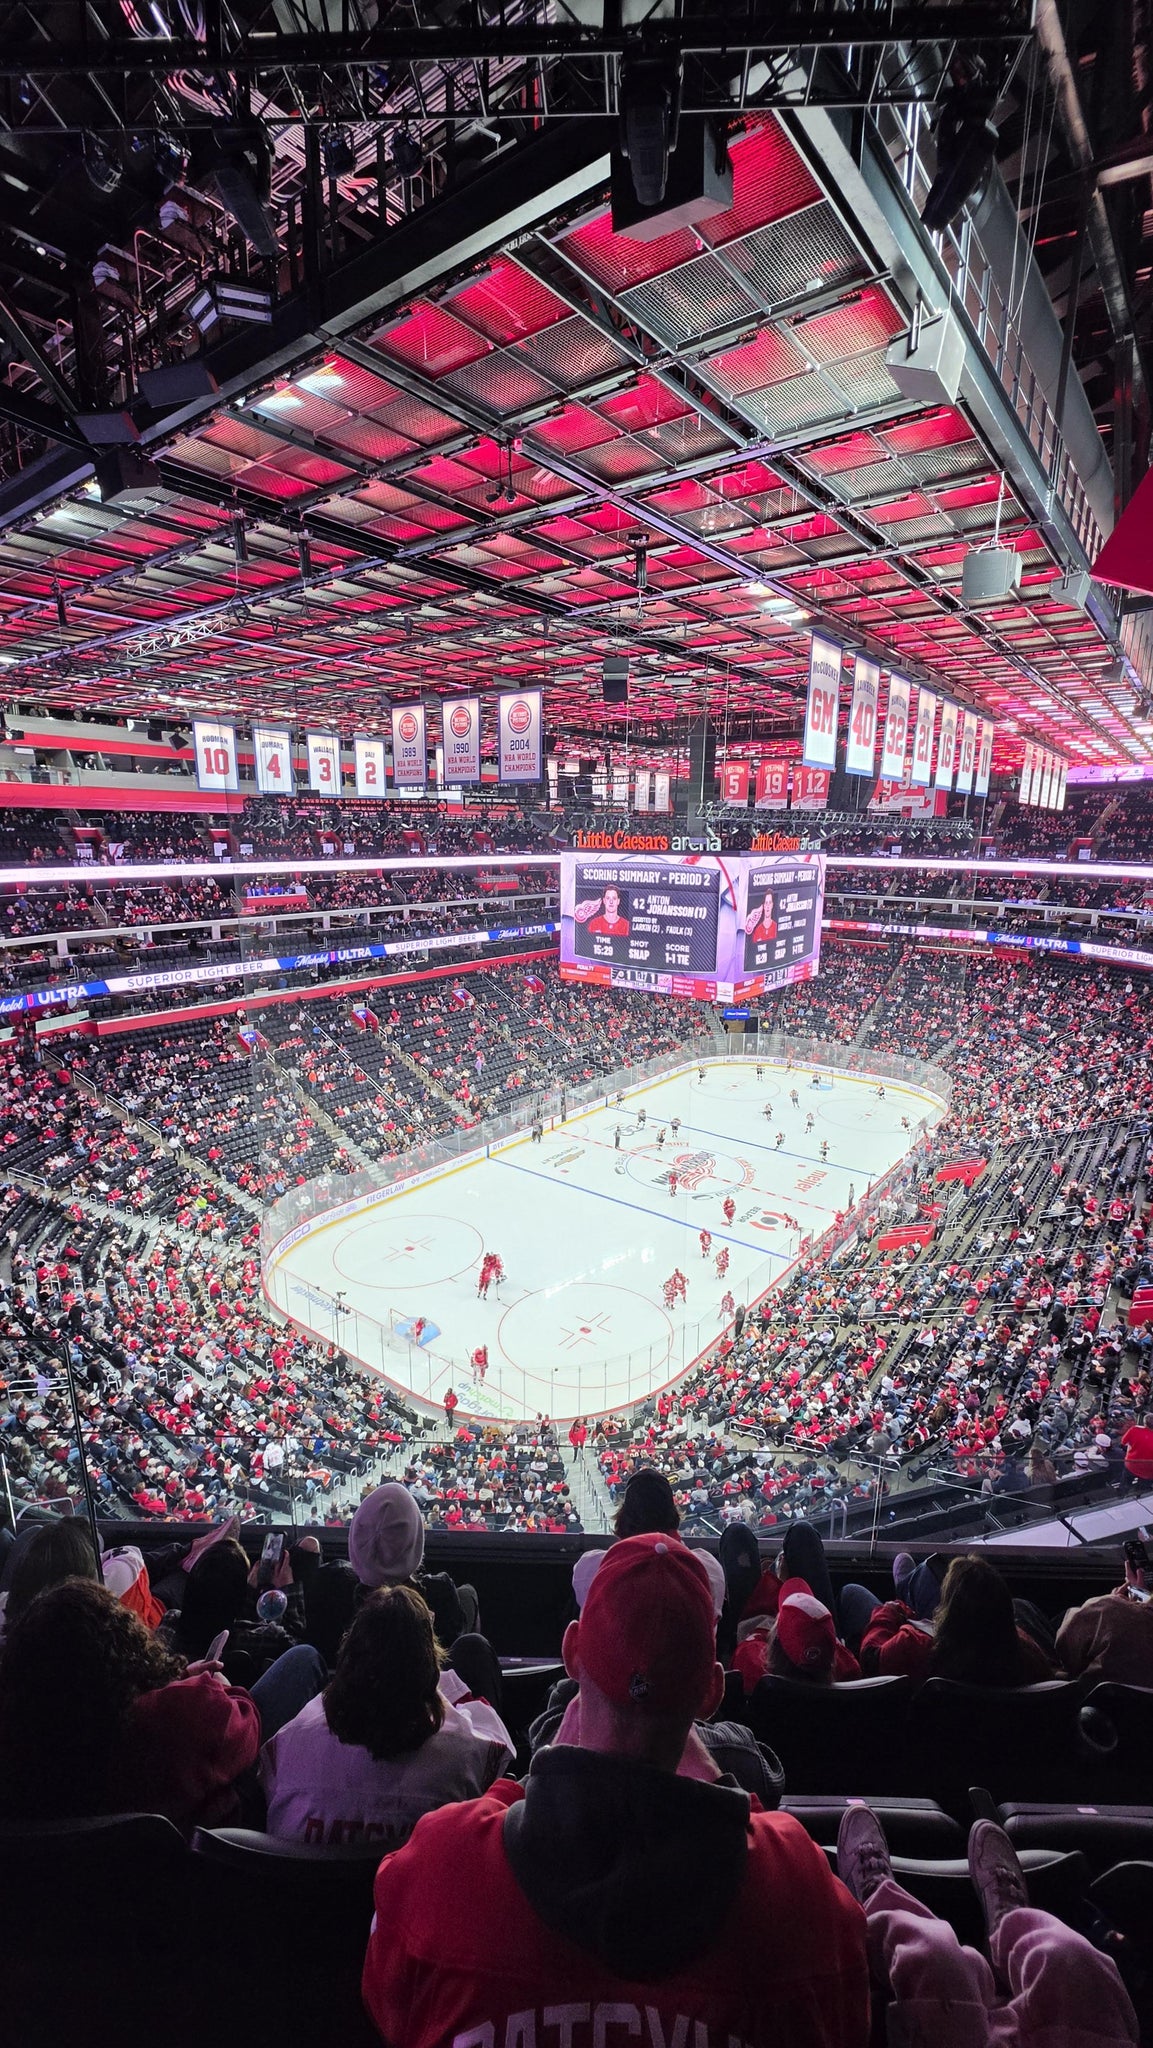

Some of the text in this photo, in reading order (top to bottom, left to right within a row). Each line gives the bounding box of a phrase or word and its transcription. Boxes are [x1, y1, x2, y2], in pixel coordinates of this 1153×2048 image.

[810, 688, 835, 734] GM
[852, 701, 874, 747] 40
[510, 739, 529, 750] 2004
[887, 713, 905, 757] 32
[917, 723, 930, 762] 21
[453, 742, 469, 754] 1990
[941, 733, 953, 768] 16
[962, 740, 973, 773] 15
[204, 747, 230, 775] 10
[266, 753, 281, 778] 4
[447, 755, 476, 764] NBA WORLD
[504, 764, 536, 772] CHAMPIONS
[981, 748, 988, 777] 11
[319, 757, 331, 782] 3
[365, 762, 376, 784] 2
[397, 769, 422, 777] CHAMPIONS
[448, 766, 476, 774] CHAMPIONS
[729, 775, 740, 794] 5
[765, 773, 783, 794] 19
[806, 772, 826, 793] 12
[577, 829, 722, 852] Little Caesars arena
[751, 832, 772, 851] Little
[773, 832, 800, 851] Caesars
[583, 868, 618, 881] SCORING
[619, 870, 660, 884] SUMMARY
[669, 872, 702, 885] PERIOD
[703, 874, 711, 886] 2
[632, 898, 645, 910] 42
[647, 895, 671, 905] ANTON
[647, 904, 707, 919] JOHANSSON (1)
[525, 925, 547, 935] ULTRA
[395, 934, 476, 951] SUPERIOR LIGHT BEER
[595, 936, 611, 944] TIME
[630, 940, 649, 948] SHOT
[665, 944, 690, 953] SCORE
[1034, 938, 1068, 950] ULTRA
[337, 947, 372, 960] ULTRA
[628, 949, 650, 960] SNAP
[678, 953, 689, 965] TIE
[1090, 945, 1153, 964] SUPERIOR LIGH
[127, 962, 264, 987] SUPERIOR LIGHT BEER
[0, 985, 88, 1013] helob ULTRA
[773, 1058, 803, 1068] GECO
[366, 1183, 405, 1205] FIEGERLAW
[278, 1223, 311, 1255] GEICO
[457, 1392, 497, 1417] ortgag
